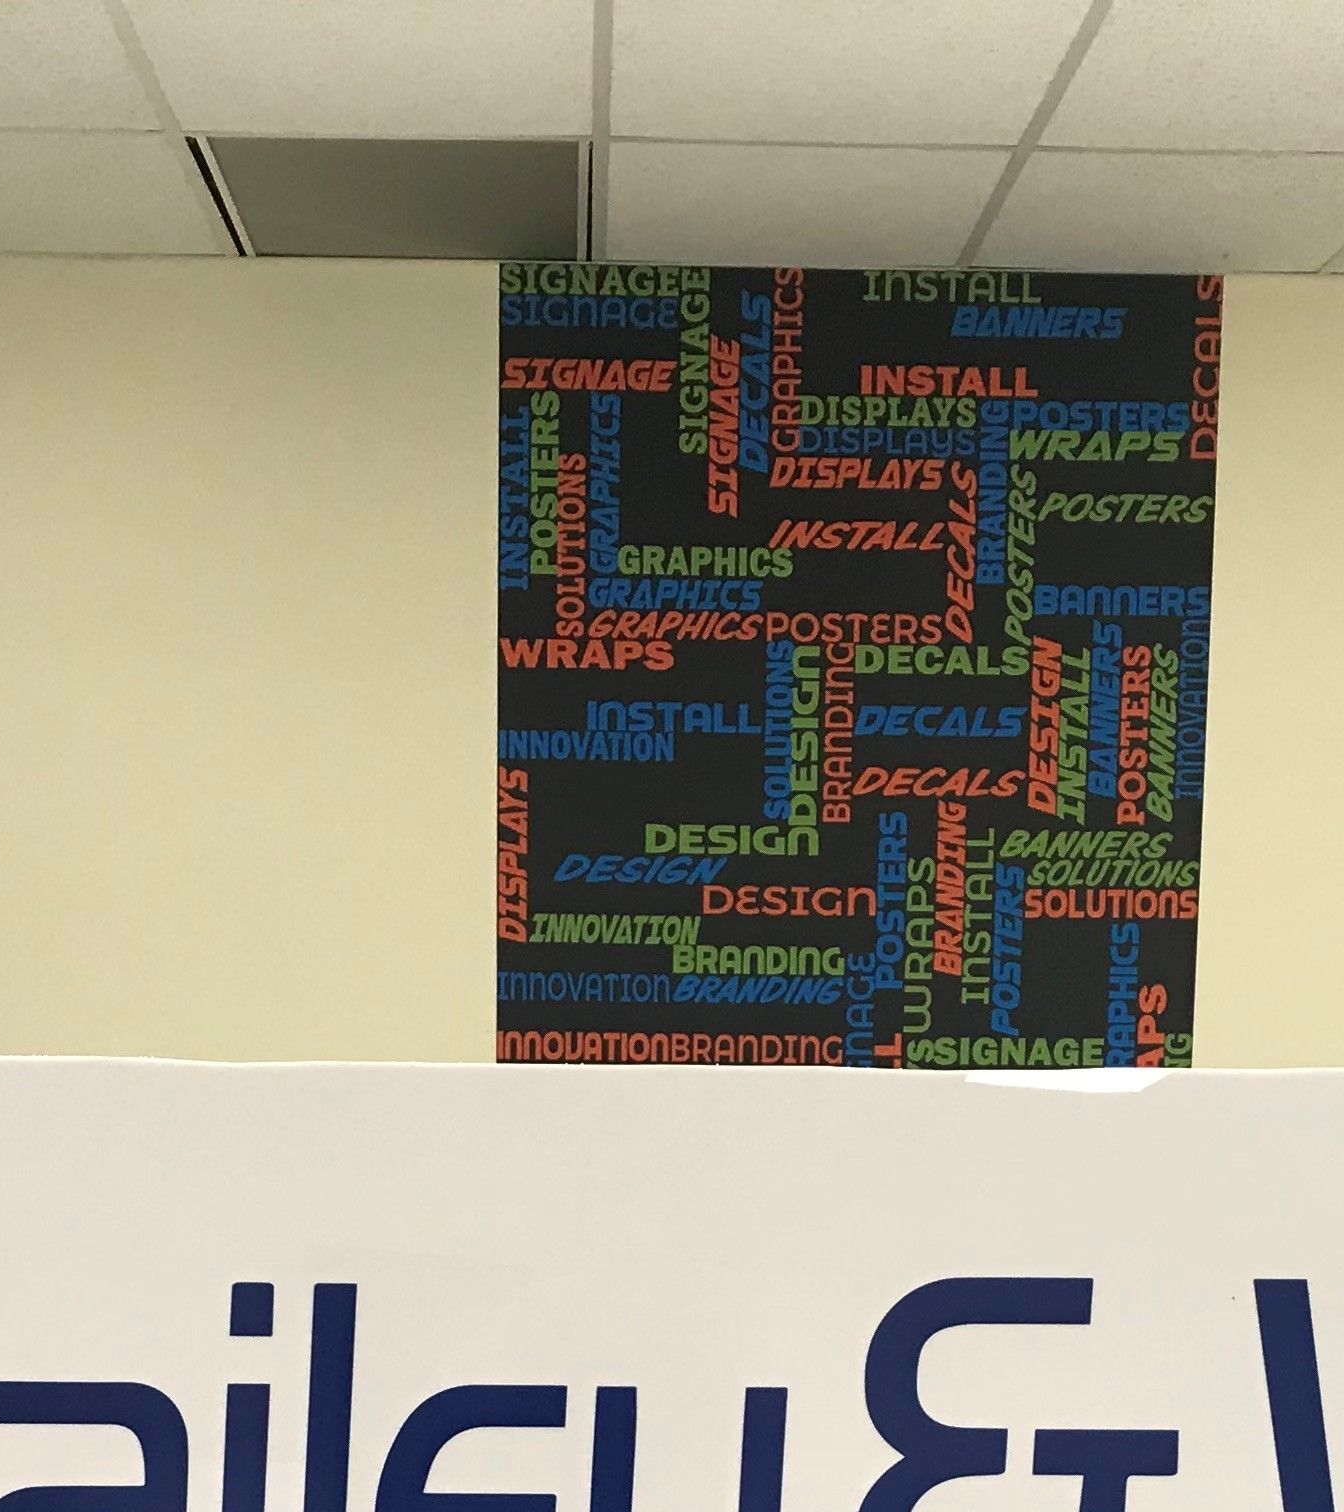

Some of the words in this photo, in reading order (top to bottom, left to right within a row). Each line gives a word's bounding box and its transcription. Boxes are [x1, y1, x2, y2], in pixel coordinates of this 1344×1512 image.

[500, 263, 681, 297] SIGNAGE
[862, 270, 1042, 303] INSTALL
[502, 295, 679, 328] SIGNAGE
[951, 305, 1128, 339] BANNERS
[501, 357, 677, 392] SIGNAGE
[678, 266, 711, 455] SIGNAGE
[772, 266, 804, 453] GRAPHICS
[1189, 275, 1224, 460] DECALS
[739, 288, 772, 474] DECALS
[860, 364, 1039, 398] INSTALL
[708, 333, 741, 519] SIGNAGE
[800, 395, 977, 428] DISPLAYS
[1013, 401, 1191, 432] POSTERS
[799, 425, 977, 458] DISPLAYS
[1009, 430, 1186, 463] WRAPS
[530, 390, 561, 575] POSTERS
[589, 392, 622, 575] GRAPHICS
[769, 456, 947, 490] DISPLAYS
[500, 406, 529, 591] INSTALL
[976, 400, 1010, 585] BRANDING
[1037, 492, 1214, 524] POSTERS
[557, 452, 587, 638] SOLUTIONS
[769, 519, 946, 551] INSTALL
[945, 461, 977, 643] DECALS
[618, 545, 795, 578] GRAPHICS
[1004, 464, 1037, 648] POSTERS
[588, 577, 763, 612] GRAPHICS
[1034, 583, 1209, 617] BANNERS
[589, 609, 764, 641] GRAPHICS
[766, 612, 943, 645] POSTERS
[500, 637, 675, 670] WRAPS
[855, 645, 1030, 676] DECALS
[587, 700, 761, 734] INSTALL
[855, 705, 1028, 737] DECALS
[1087, 619, 1123, 799] BANNERS
[1175, 614, 1210, 800] INNOVATION
[763, 640, 795, 820] SOLUTIONS
[788, 645, 821, 827] DESIGN
[822, 641, 855, 823] BRANDING
[1027, 635, 1062, 816] DESIGN
[1056, 647, 1090, 826] INSTALL
[1117, 645, 1152, 826] POSTERS
[1145, 642, 1180, 822] BANNERS
[499, 730, 675, 762] INNOVATION
[852, 767, 1026, 798] DECALS
[498, 765, 529, 943] DISPLAYS
[644, 823, 820, 857] DESIGN
[999, 830, 1173, 859] BANNERS
[554, 853, 728, 885] DESIGN
[1027, 858, 1200, 888] SOLUTIONS
[702, 884, 877, 918] DESIGN
[874, 810, 908, 991] POSTERS
[933, 799, 967, 977] BRANDING
[1024, 888, 1199, 919] SOLUTIONS
[529, 913, 702, 946] INNOVATION
[961, 827, 995, 1004] INSTALL
[672, 945, 846, 976] BRANDING
[903, 856, 936, 1033] WRAPS
[991, 863, 1025, 1036] POSTERS
[498, 970, 672, 1003] INNOVATION
[672, 976, 844, 1005] BRANDING
[845, 953, 875, 1067] NAGE
[497, 1029, 673, 1061] INNOVATION
[674, 1033, 844, 1065] BRANDING
[934, 1037, 1105, 1066] SIGNAGE
